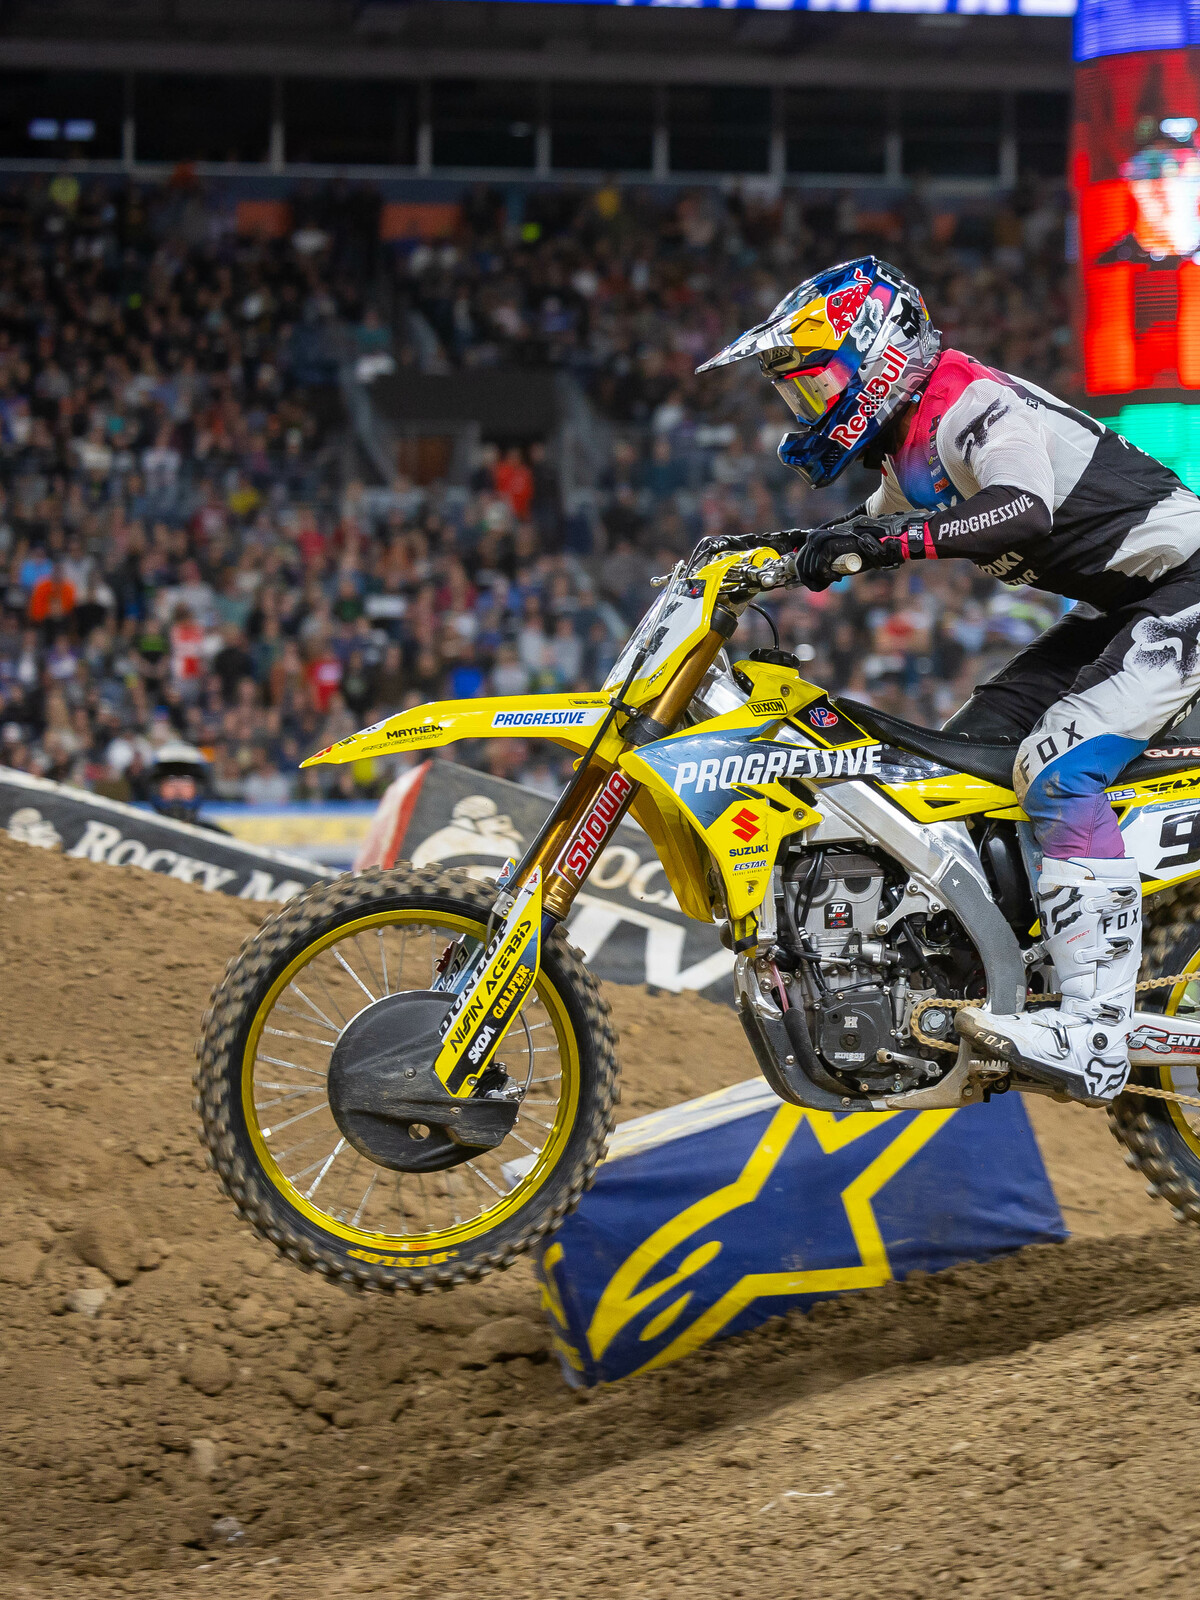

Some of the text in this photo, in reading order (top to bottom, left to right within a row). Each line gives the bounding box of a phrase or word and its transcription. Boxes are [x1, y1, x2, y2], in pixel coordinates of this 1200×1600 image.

[938, 494, 1034, 540] PROGRESSIVE
[494, 711, 587, 726] PROGRESSIVE
[752, 700, 784, 714] DIXXON
[386, 724, 443, 740] MAYHEM
[673, 744, 883, 795] PROGRESSIVE
[1019, 720, 1084, 785] FOX
[565, 770, 633, 880] SHOWA
[67, 820, 238, 893] ROCKY
[729, 844, 769, 858] SUZUKI
[733, 860, 768, 872] ECSTAR
[1066, 930, 1091, 944] INSTINCT
[1102, 907, 1139, 934] FOX
[485, 920, 532, 995] ACERBIS
[438, 919, 508, 1038] DUNLOP
[493, 964, 530, 1019] GALFER
[467, 1025, 496, 1064] SKDA
[974, 1031, 1010, 1050] FOX
